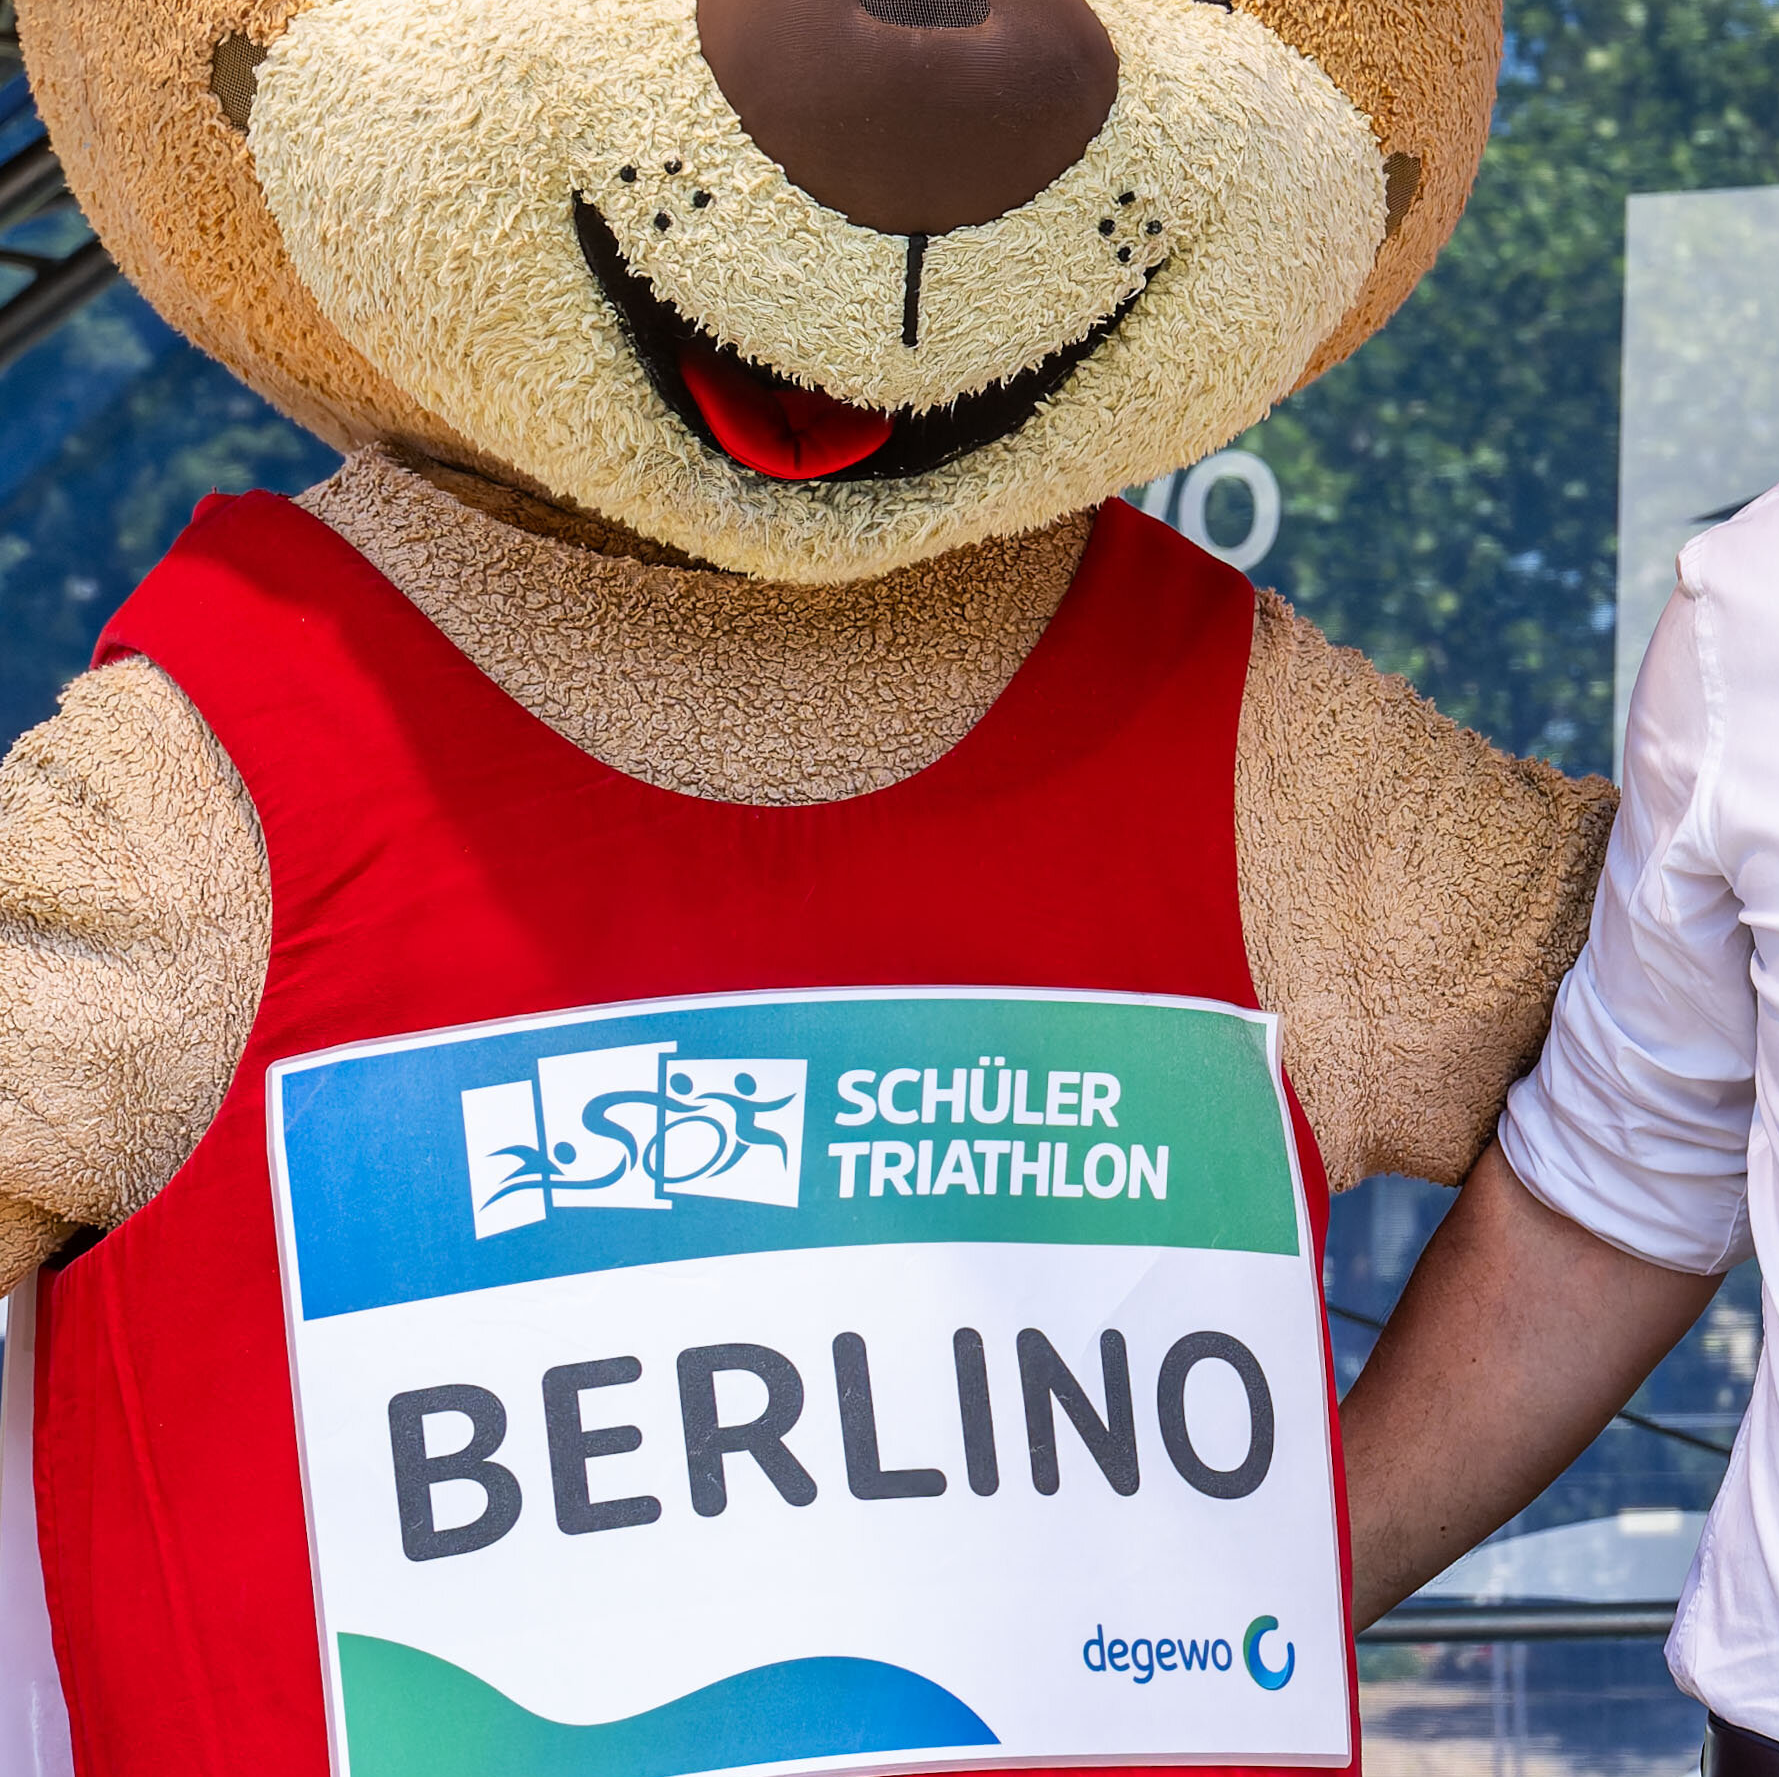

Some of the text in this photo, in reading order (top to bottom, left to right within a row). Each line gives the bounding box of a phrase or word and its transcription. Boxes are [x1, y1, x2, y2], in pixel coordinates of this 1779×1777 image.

[835, 1056, 1121, 1127] SCHÜLER
[828, 1139, 1169, 1200] TRIATHLON
[387, 1325, 1275, 1564] BERLINO
[1083, 1623, 1232, 1684] degewo
